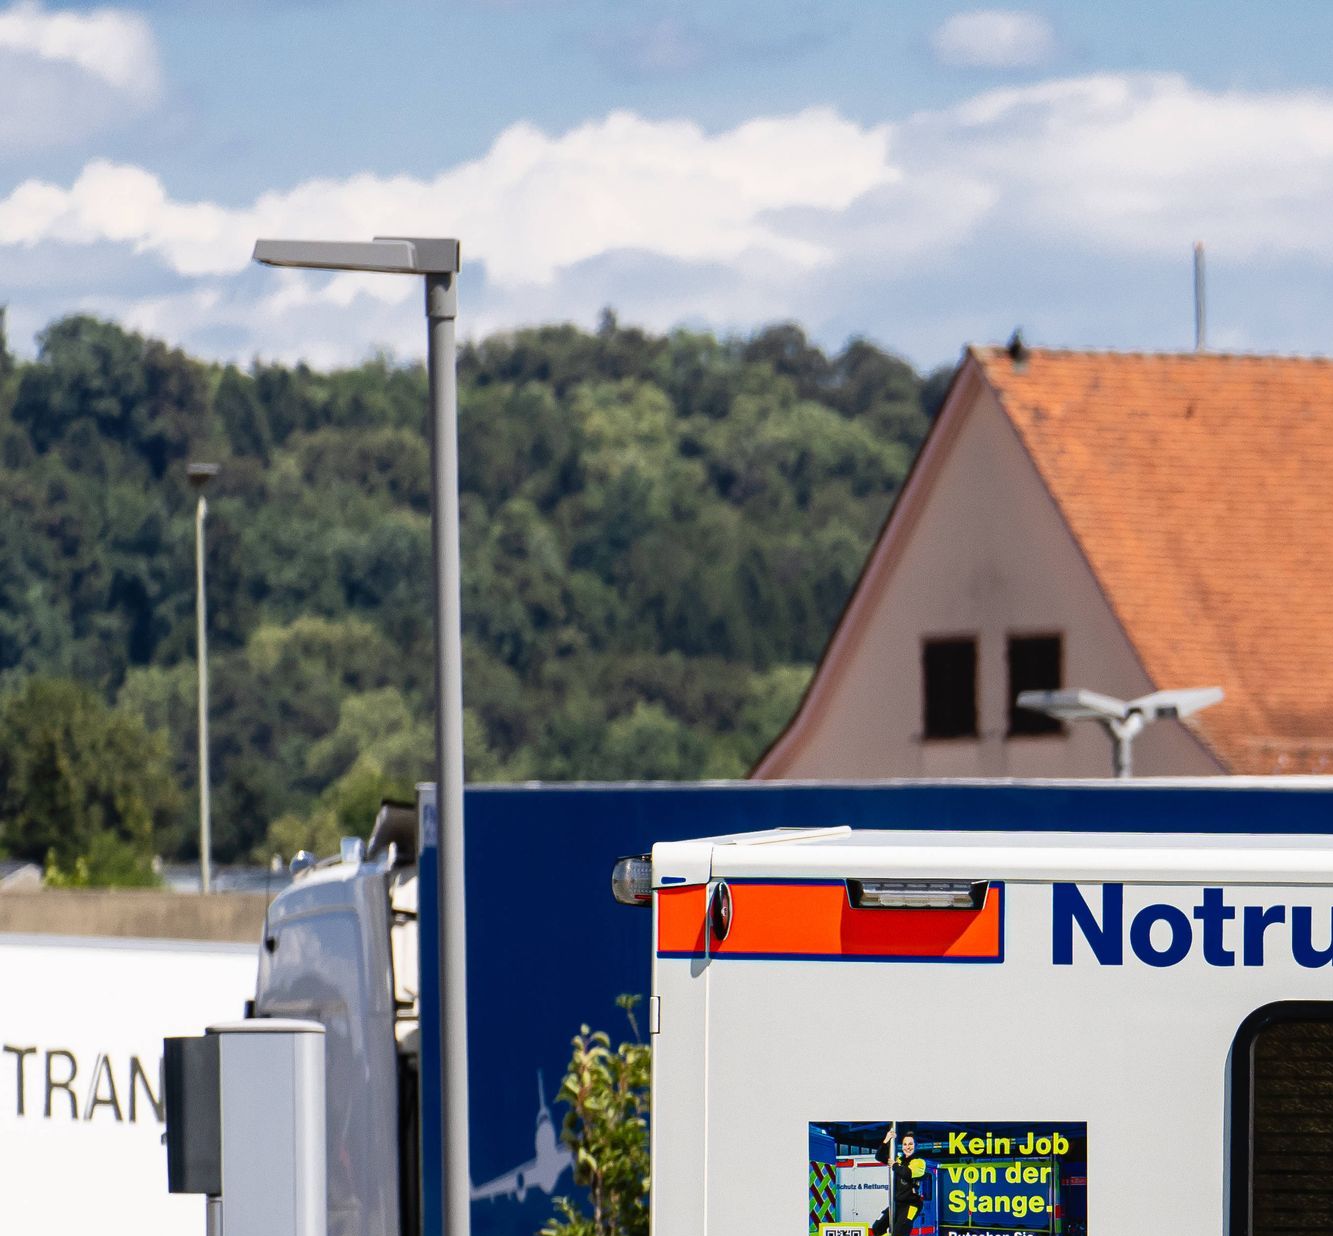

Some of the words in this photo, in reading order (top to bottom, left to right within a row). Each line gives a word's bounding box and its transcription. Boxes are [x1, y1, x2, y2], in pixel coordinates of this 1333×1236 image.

[948, 1132, 1011, 1155] Kein
[1019, 1132, 1069, 1155] Job
[948, 1167, 996, 1184] von
[1004, 1161, 1051, 1184] der
[948, 1190, 1053, 1218] Stange.
